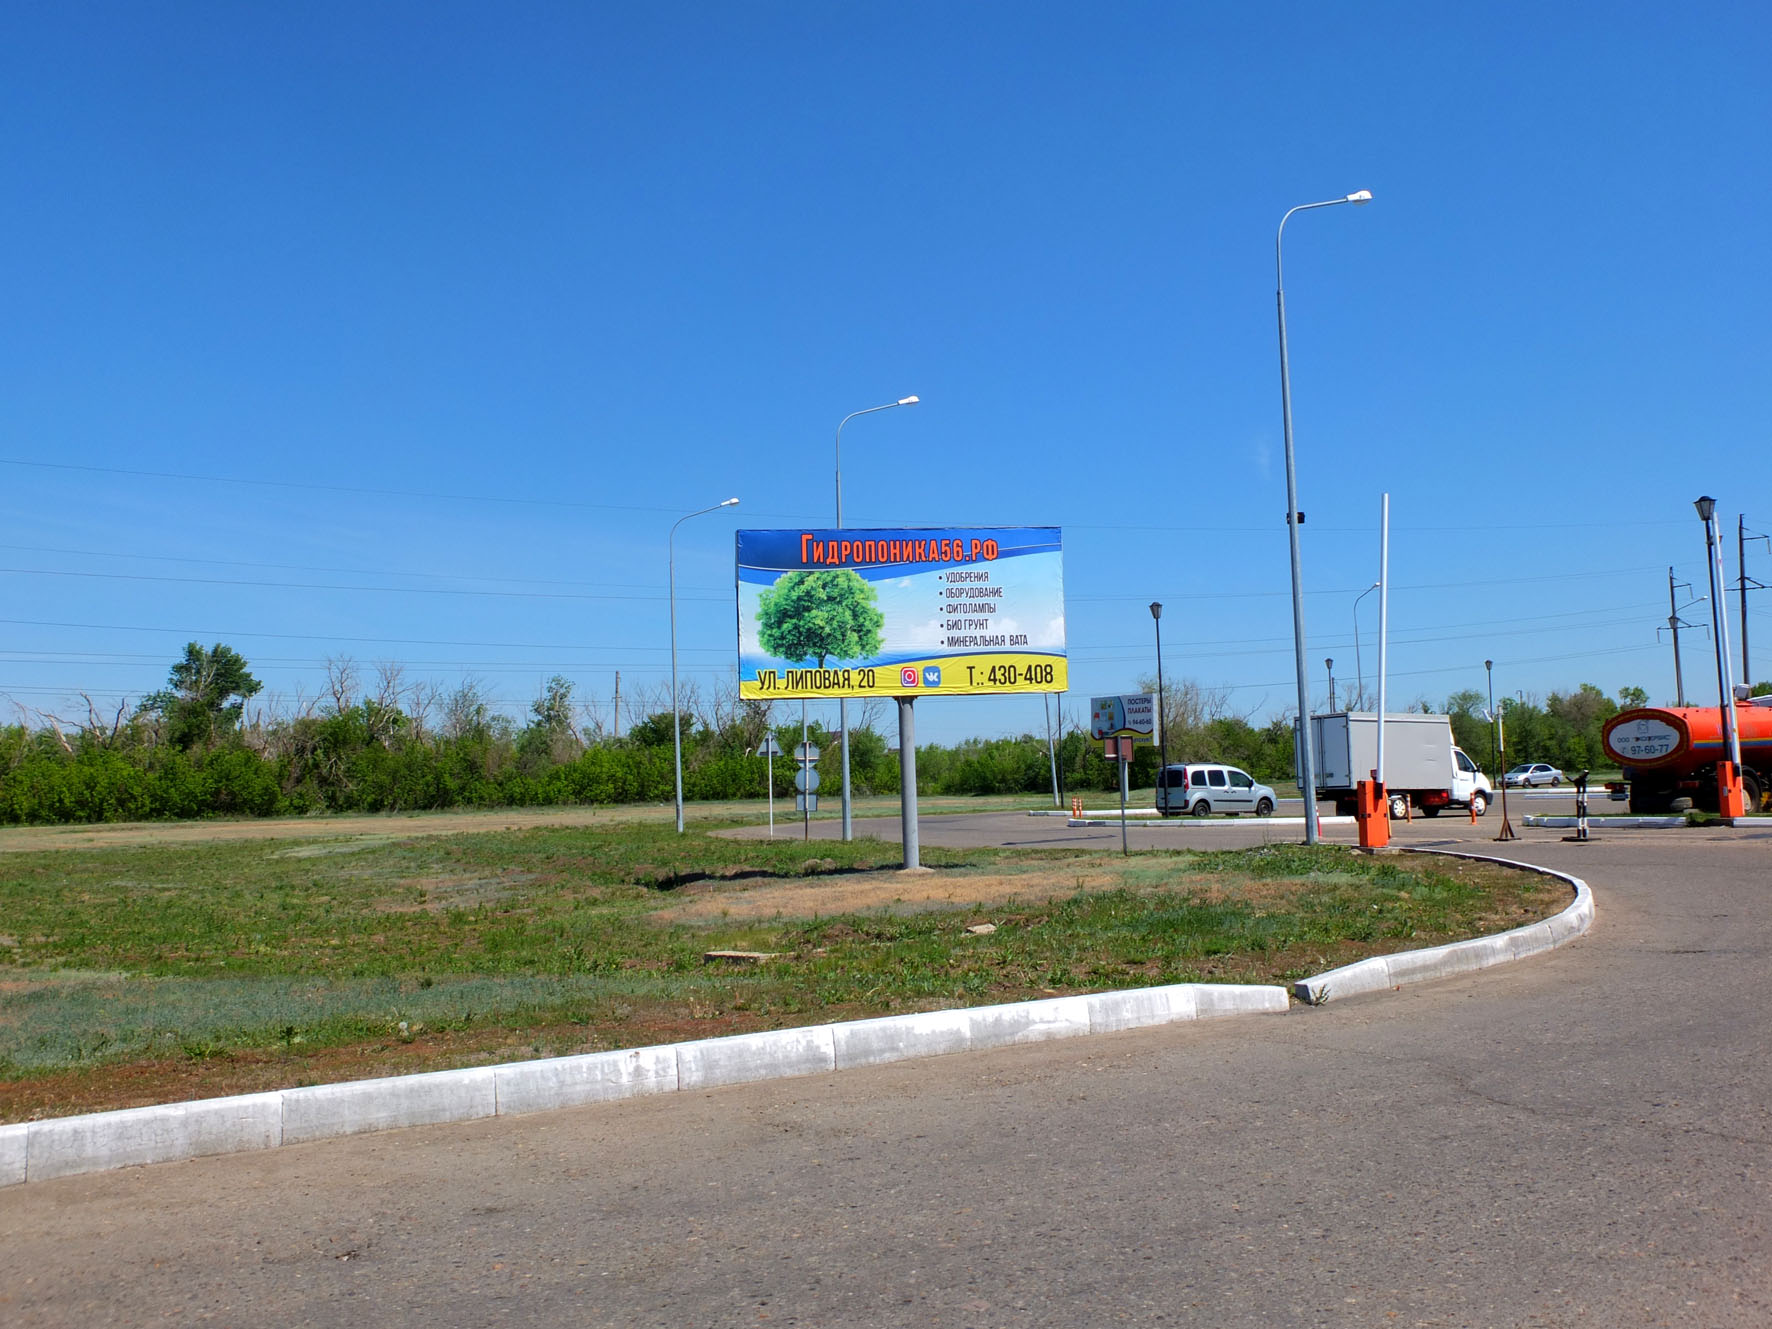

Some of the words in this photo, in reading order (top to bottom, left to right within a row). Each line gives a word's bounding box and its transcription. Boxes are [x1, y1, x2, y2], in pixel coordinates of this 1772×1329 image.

[945, 571, 989, 583] УДОБРЕНИЯ
[945, 587, 1003, 599] ОБОРУДОВАНИЕ
[946, 603, 997, 615] ФИТОЛАМПЫ
[946, 619, 963, 631] БИО
[964, 618, 989, 630] ГРУНТ
[947, 635, 1006, 647] МИНЕРАЛЬНАЯ
[1009, 634, 1029, 646] ВАТА
[757, 670, 781, 690] УЛ.
[784, 669, 855, 690] ЛИПОВАЯ,
[857, 668, 875, 688] 20
[987, 663, 1054, 686] 430-408
[1631, 744, 1669, 755] 97-60-77
